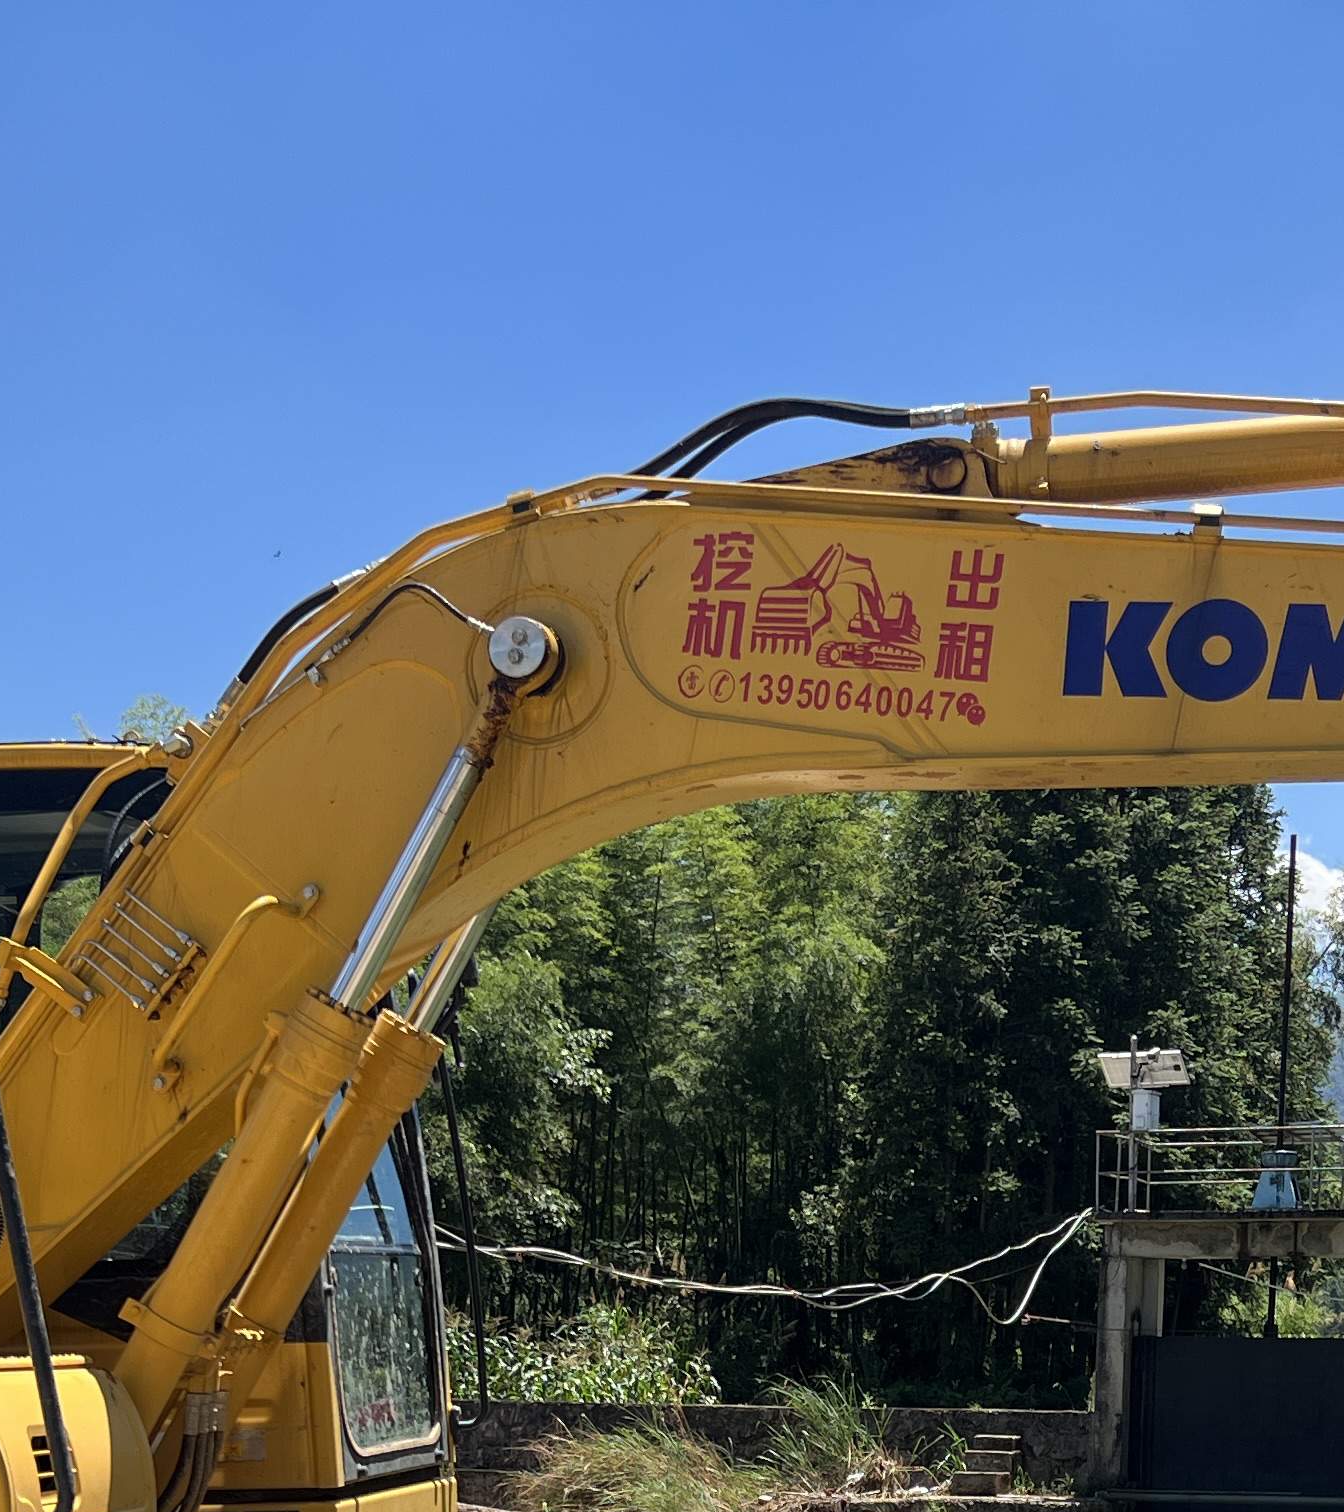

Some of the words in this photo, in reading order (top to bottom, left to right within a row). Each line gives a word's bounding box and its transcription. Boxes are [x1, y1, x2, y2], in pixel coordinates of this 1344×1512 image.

[682, 531, 755, 660] 挖机
[934, 548, 1005, 683] 出租
[739, 671, 957, 722] 13950640047
